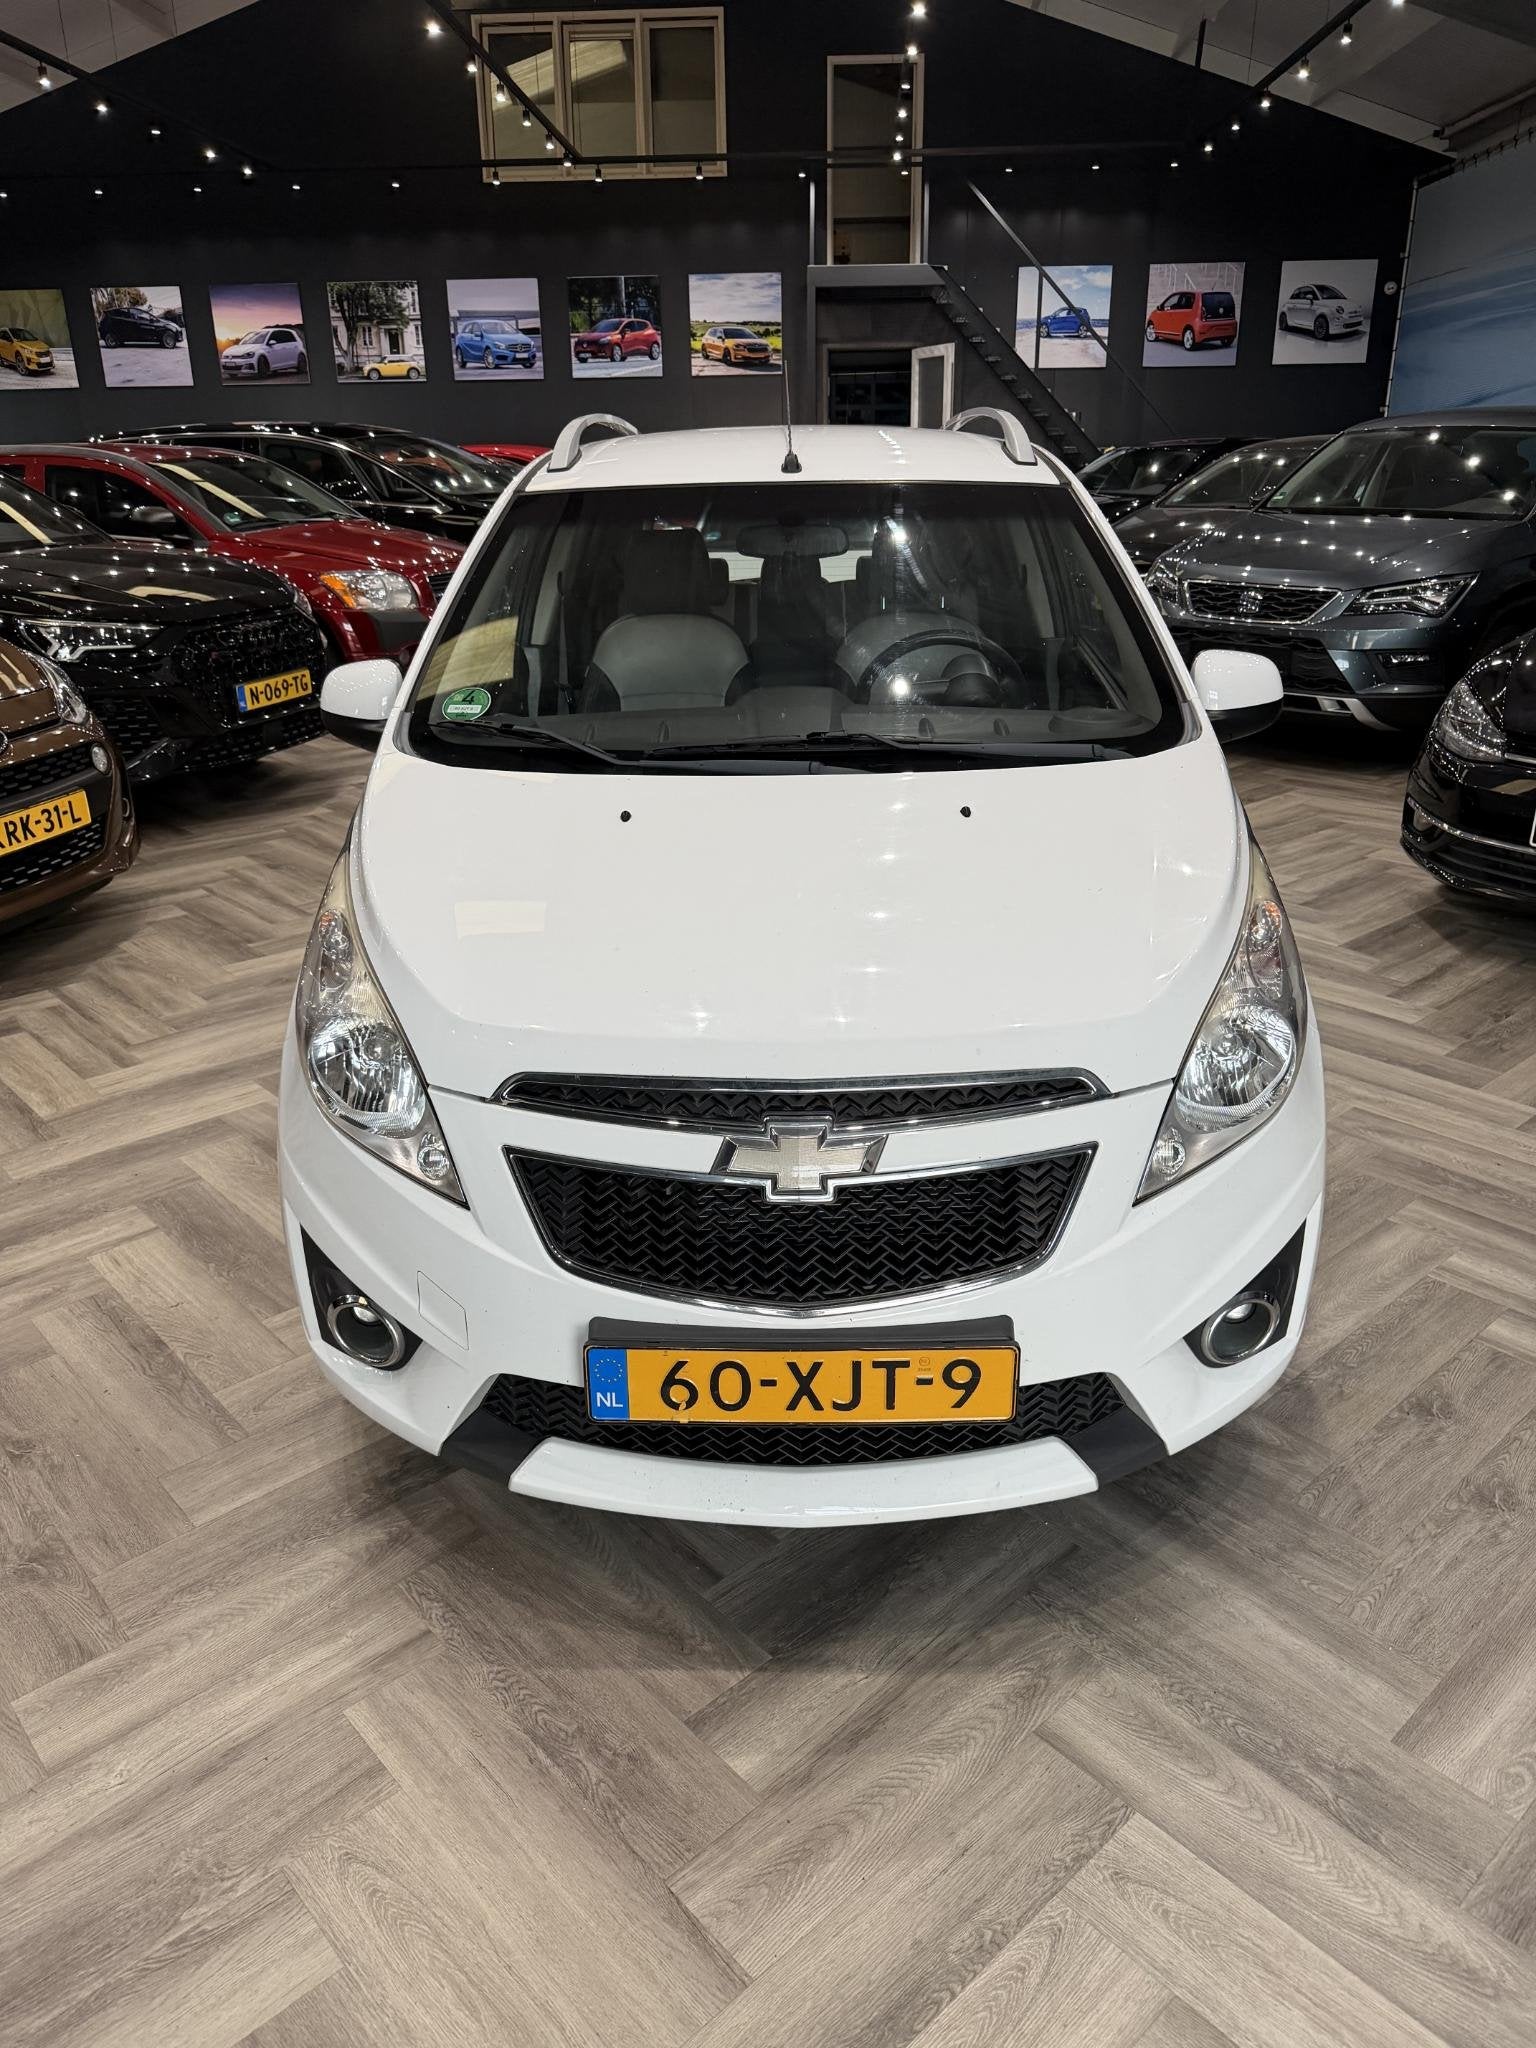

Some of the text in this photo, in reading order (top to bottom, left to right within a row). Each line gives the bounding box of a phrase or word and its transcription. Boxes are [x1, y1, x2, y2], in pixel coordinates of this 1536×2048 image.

[249, 674, 309, 705] N-069-TG
[462, 690, 476, 705] 4
[0, 800, 82, 849] RK-31-L
[596, 1391, 623, 1408] NL
[660, 1358, 982, 1412] 60-XJT-9
